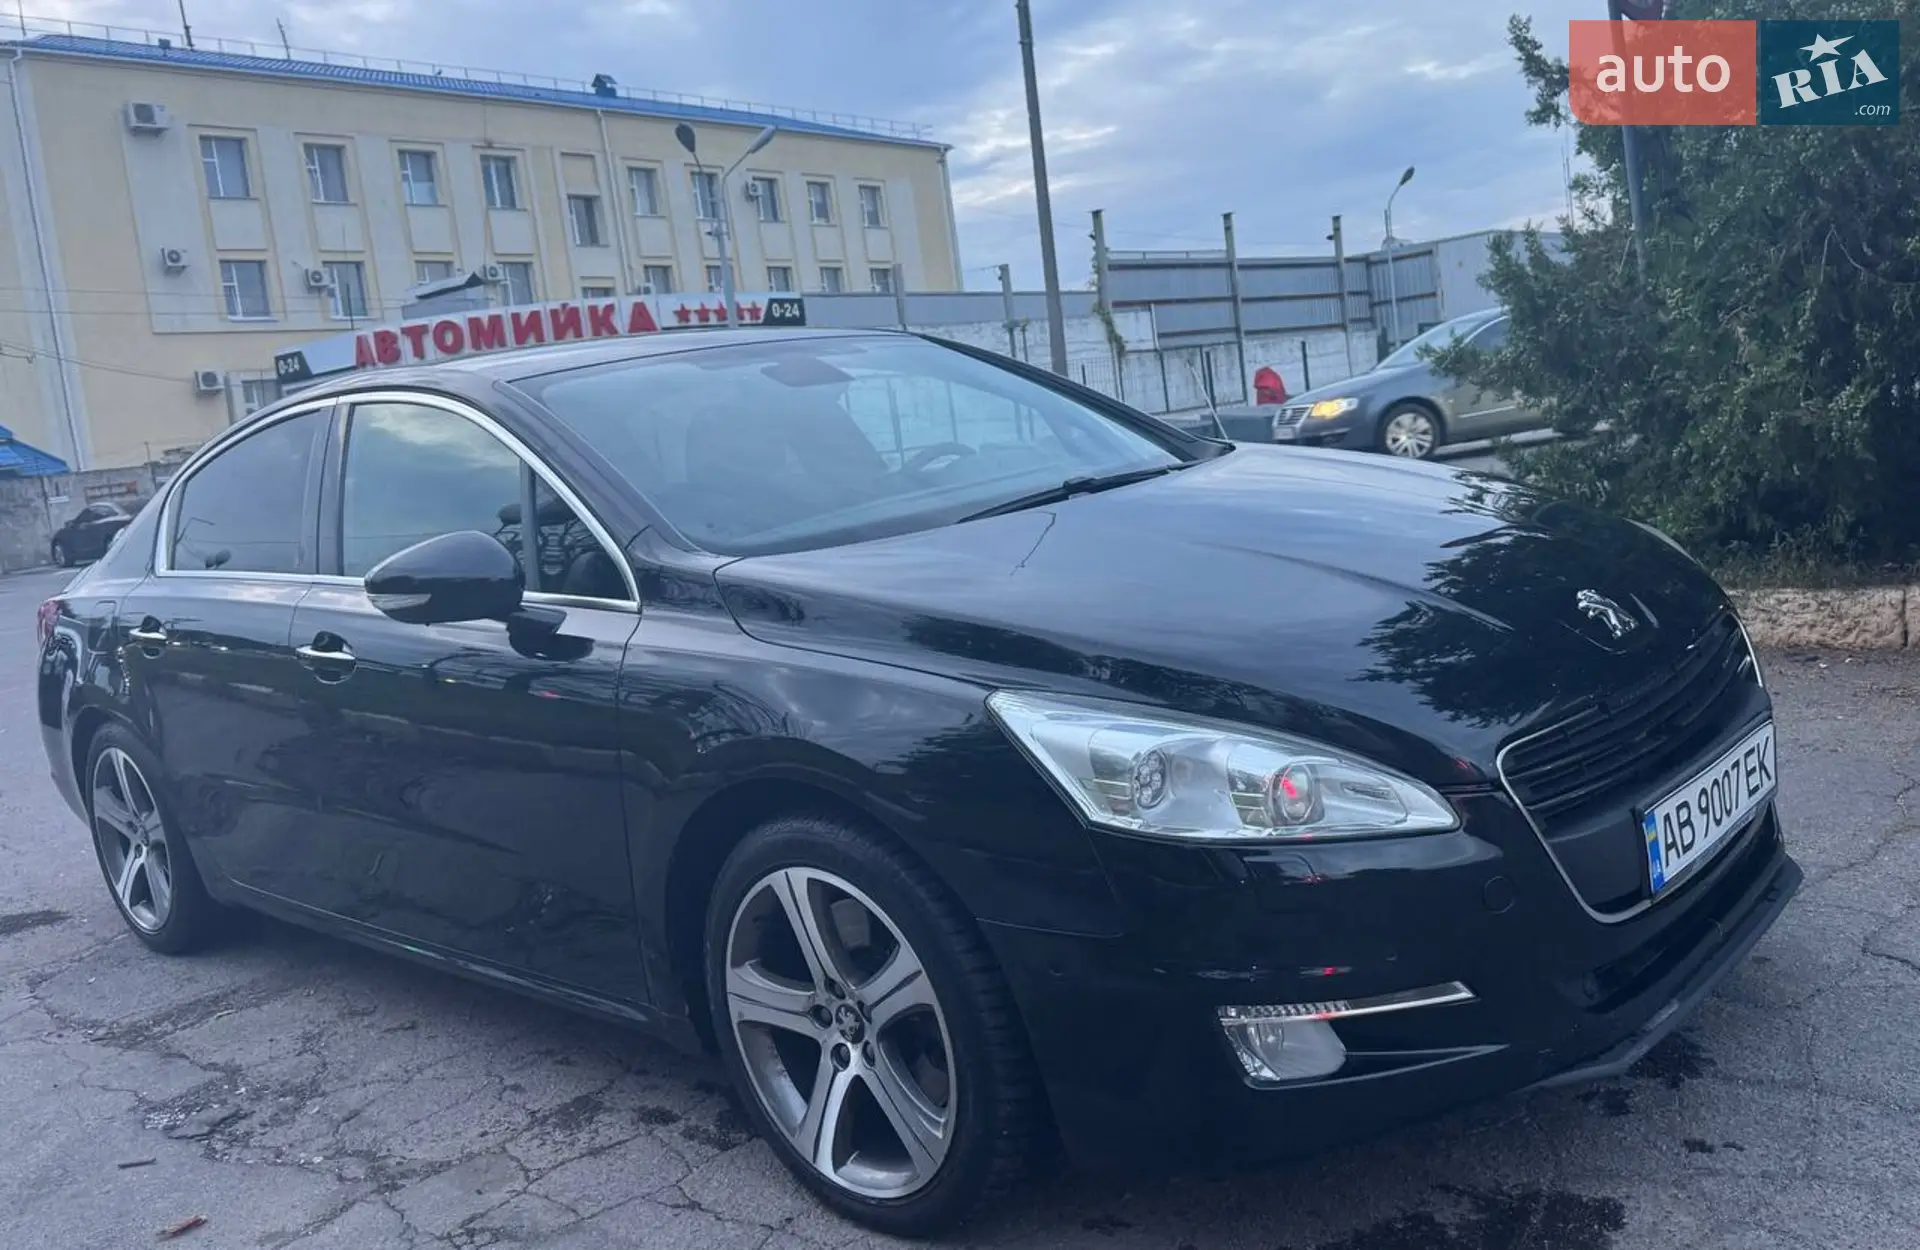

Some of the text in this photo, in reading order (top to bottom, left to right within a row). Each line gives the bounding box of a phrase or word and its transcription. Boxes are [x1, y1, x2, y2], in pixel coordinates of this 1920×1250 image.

[277, 302, 800, 375] 0-24 АВТОМИЙКА 0-24
[1663, 801, 1695, 867] AB
[1698, 759, 1740, 838] 9007
[1743, 736, 1772, 798] EK
